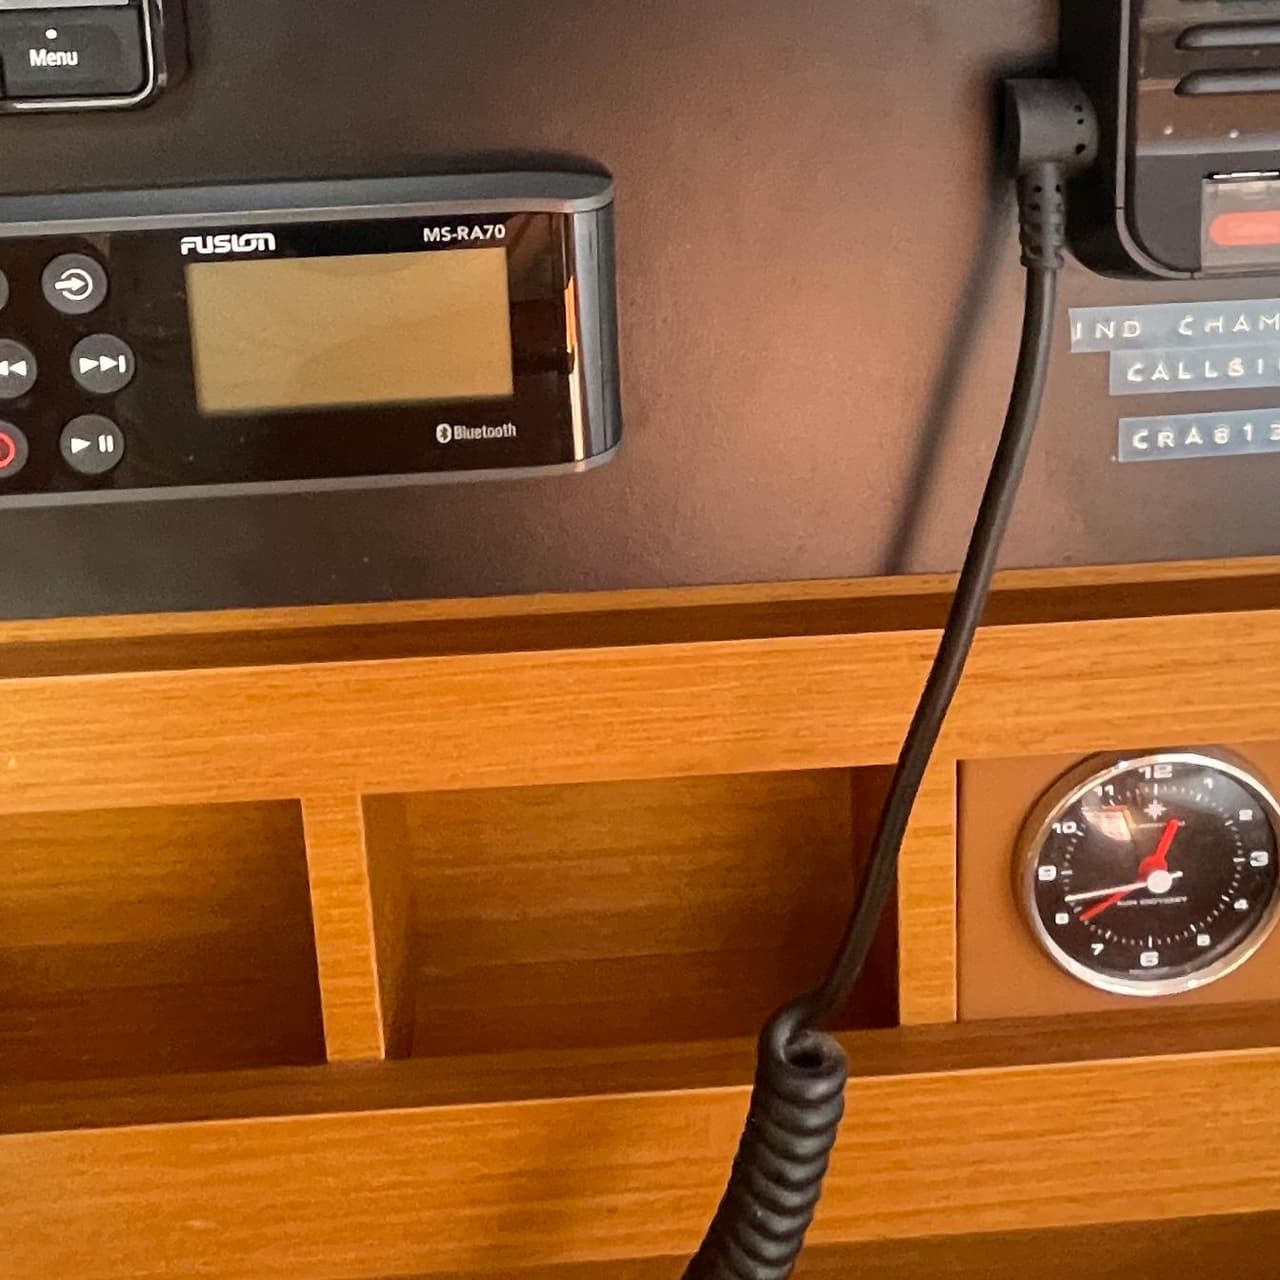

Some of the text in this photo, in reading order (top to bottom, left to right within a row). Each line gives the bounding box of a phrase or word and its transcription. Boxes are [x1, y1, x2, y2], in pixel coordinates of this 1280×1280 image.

[29, 47, 79, 67] Menu
[180, 223, 507, 255] FUSION MS-RA70
[1072, 319, 1142, 342] IND
[453, 422, 517, 440] Bluetooth
[1051, 821, 1078, 835] 10
[1090, 942, 1105, 956] 7
